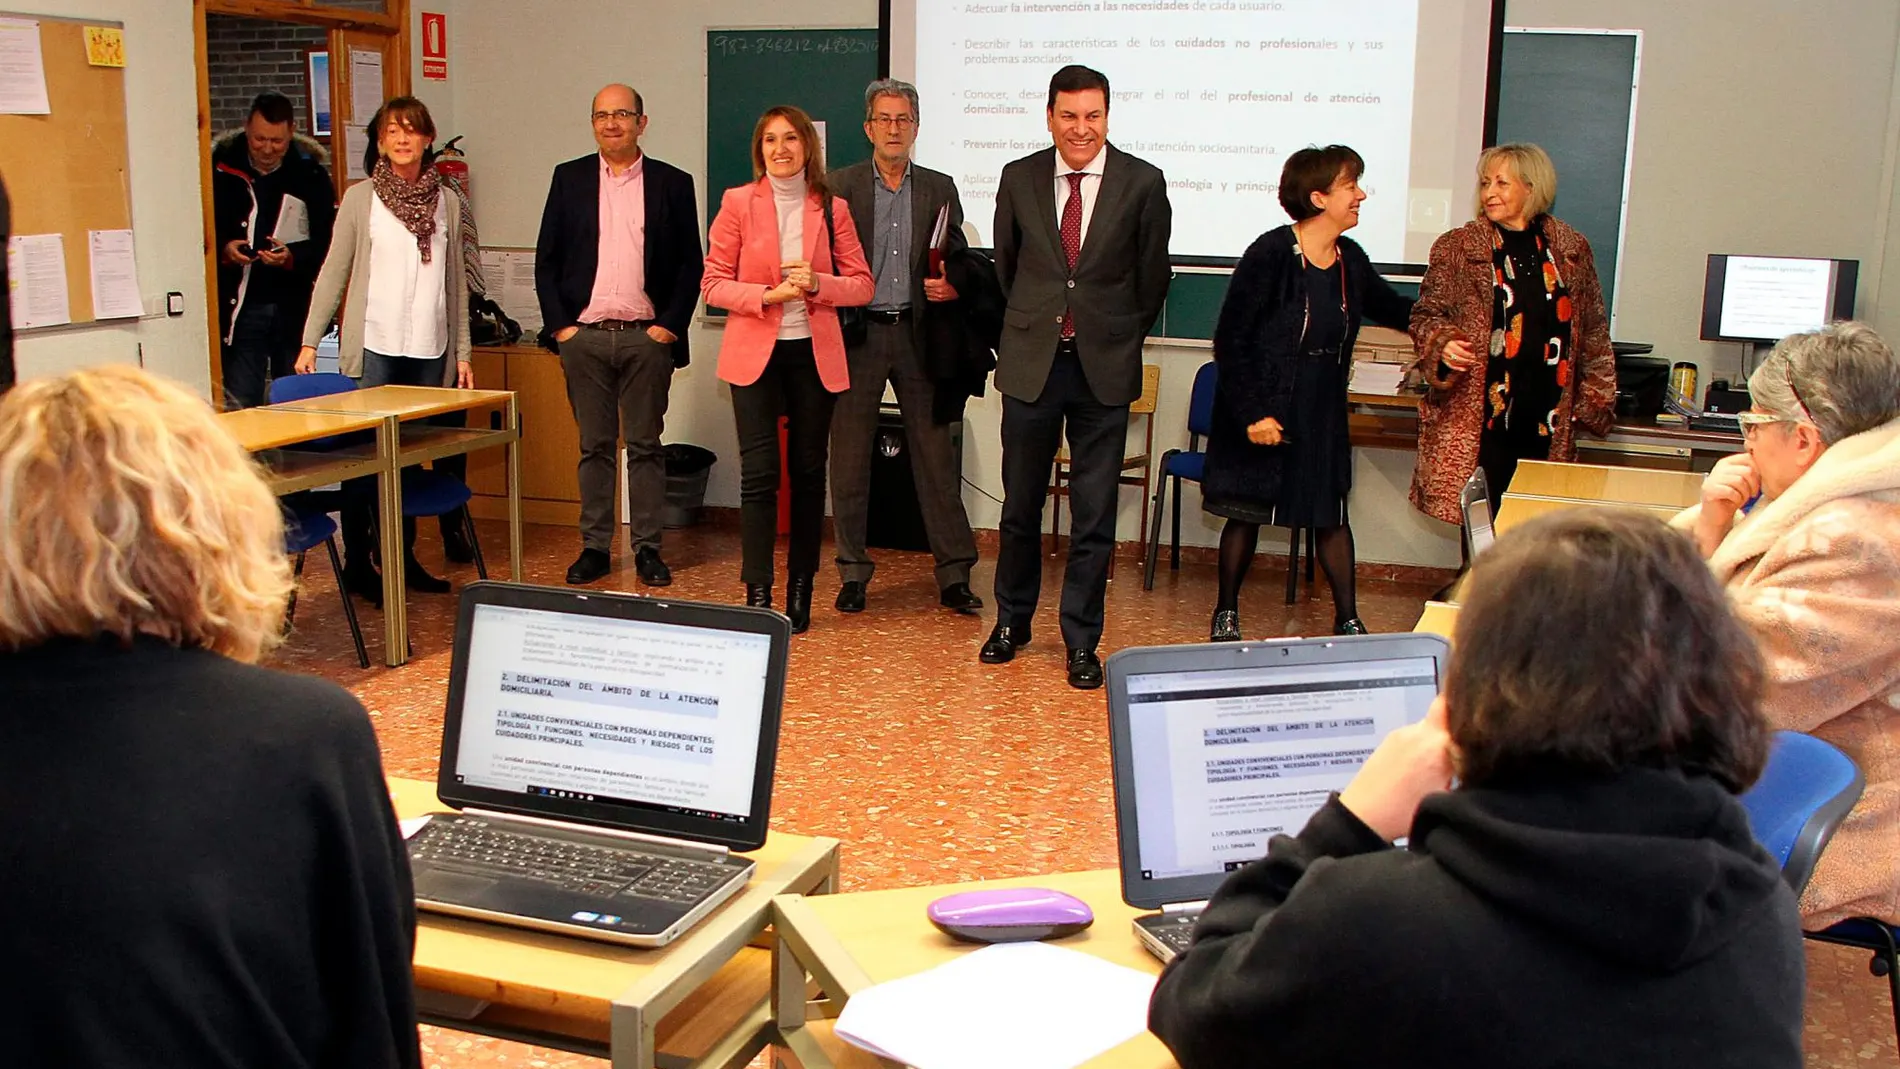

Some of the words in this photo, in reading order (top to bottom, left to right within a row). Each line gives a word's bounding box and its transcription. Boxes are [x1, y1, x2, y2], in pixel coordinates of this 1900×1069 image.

[965, 3, 1008, 13] Adecuar
[1011, 2, 1020, 12] la
[1023, 1, 1091, 12] intervención
[1103, 1, 1118, 11] las
[1121, 0, 1189, 11] necesidades
[1193, 1, 1206, 11] de
[1209, 1, 1236, 11] cada
[1239, 1, 1285, 11] usuario.
[964, 39, 1010, 49] Describir
[1019, 39, 1034, 48] las
[1042, 38, 1118, 48] características
[1127, 38, 1141, 48] de
[1149, 38, 1165, 48] los
[1174, 38, 1226, 48] cuidados
[1235, 40, 1250, 48] no
[1259, 38, 1338, 50] profesionales
[1347, 41, 1355, 51] y
[1364, 41, 1384, 50] sus
[964, 53, 1020, 65] problemas
[963, 89, 1009, 100] Conocer,
[1018, 88, 1048, 99] desar
[1111, 89, 1143, 101] tegrar
[1154, 90, 1165, 99] el
[1174, 90, 1190, 100] rol
[1200, 90, 1218, 100] del
[1227, 91, 1293, 103] profesional
[1303, 92, 1318, 102] de
[1329, 93, 1381, 104] atención
[963, 104, 1029, 115] domiciliaria.
[963, 140, 1008, 149] Prevenir
[1009, 140, 1024, 149] los
[1027, 141, 1052, 150] ries
[1135, 141, 1145, 151] la
[1148, 141, 1195, 152] atención
[1198, 143, 1280, 155] sociosanitaria.
[962, 174, 997, 186] Aplicar
[1167, 179, 1213, 191] inología
[1220, 182, 1228, 192] y
[1235, 181, 1279, 196] principi
[501, 673, 509, 681] 2.
[578, 681, 594, 691] DEL
[601, 683, 633, 696] ÁMBITO
[640, 689, 652, 698] DE
[659, 691, 670, 700] LA
[678, 694, 720, 706] ATENCIÓN
[511, 711, 545, 722] UNIDADES
[546, 715, 604, 730] CONVIVENCIALES
[604, 723, 620, 732] CON
[620, 726, 657, 738] PERSONAS
[495, 729, 537, 741] CUIDADORES
[496, 719, 532, 731] TIPOLOGÍA
[589, 731, 637, 745] NECESIDADES
[650, 739, 681, 750] RIESGOS
[685, 744, 695, 752] DE
[699, 744, 714, 755] LOS
